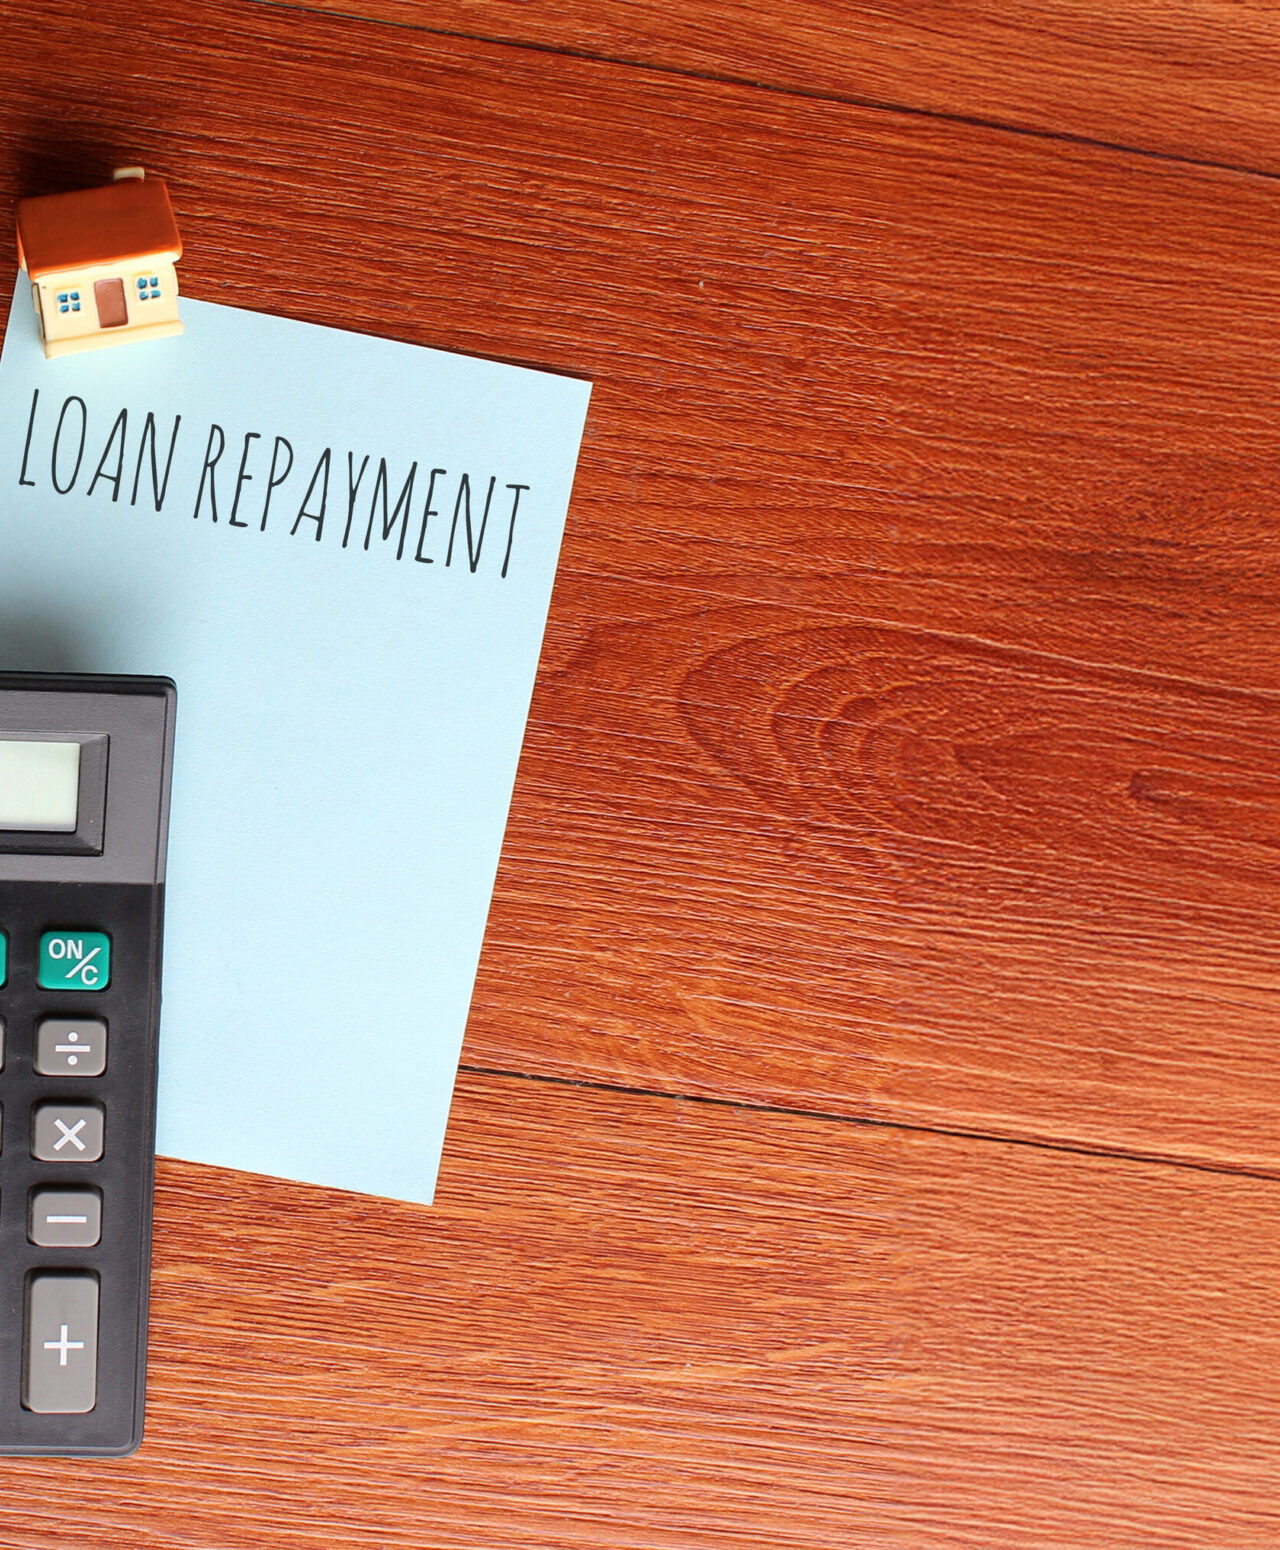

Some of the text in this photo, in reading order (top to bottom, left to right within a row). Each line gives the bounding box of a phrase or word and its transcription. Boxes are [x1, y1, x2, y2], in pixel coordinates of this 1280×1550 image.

[18, 388, 530, 578] LOAN REPAYMENT
[43, 1324, 84, 1366] +
